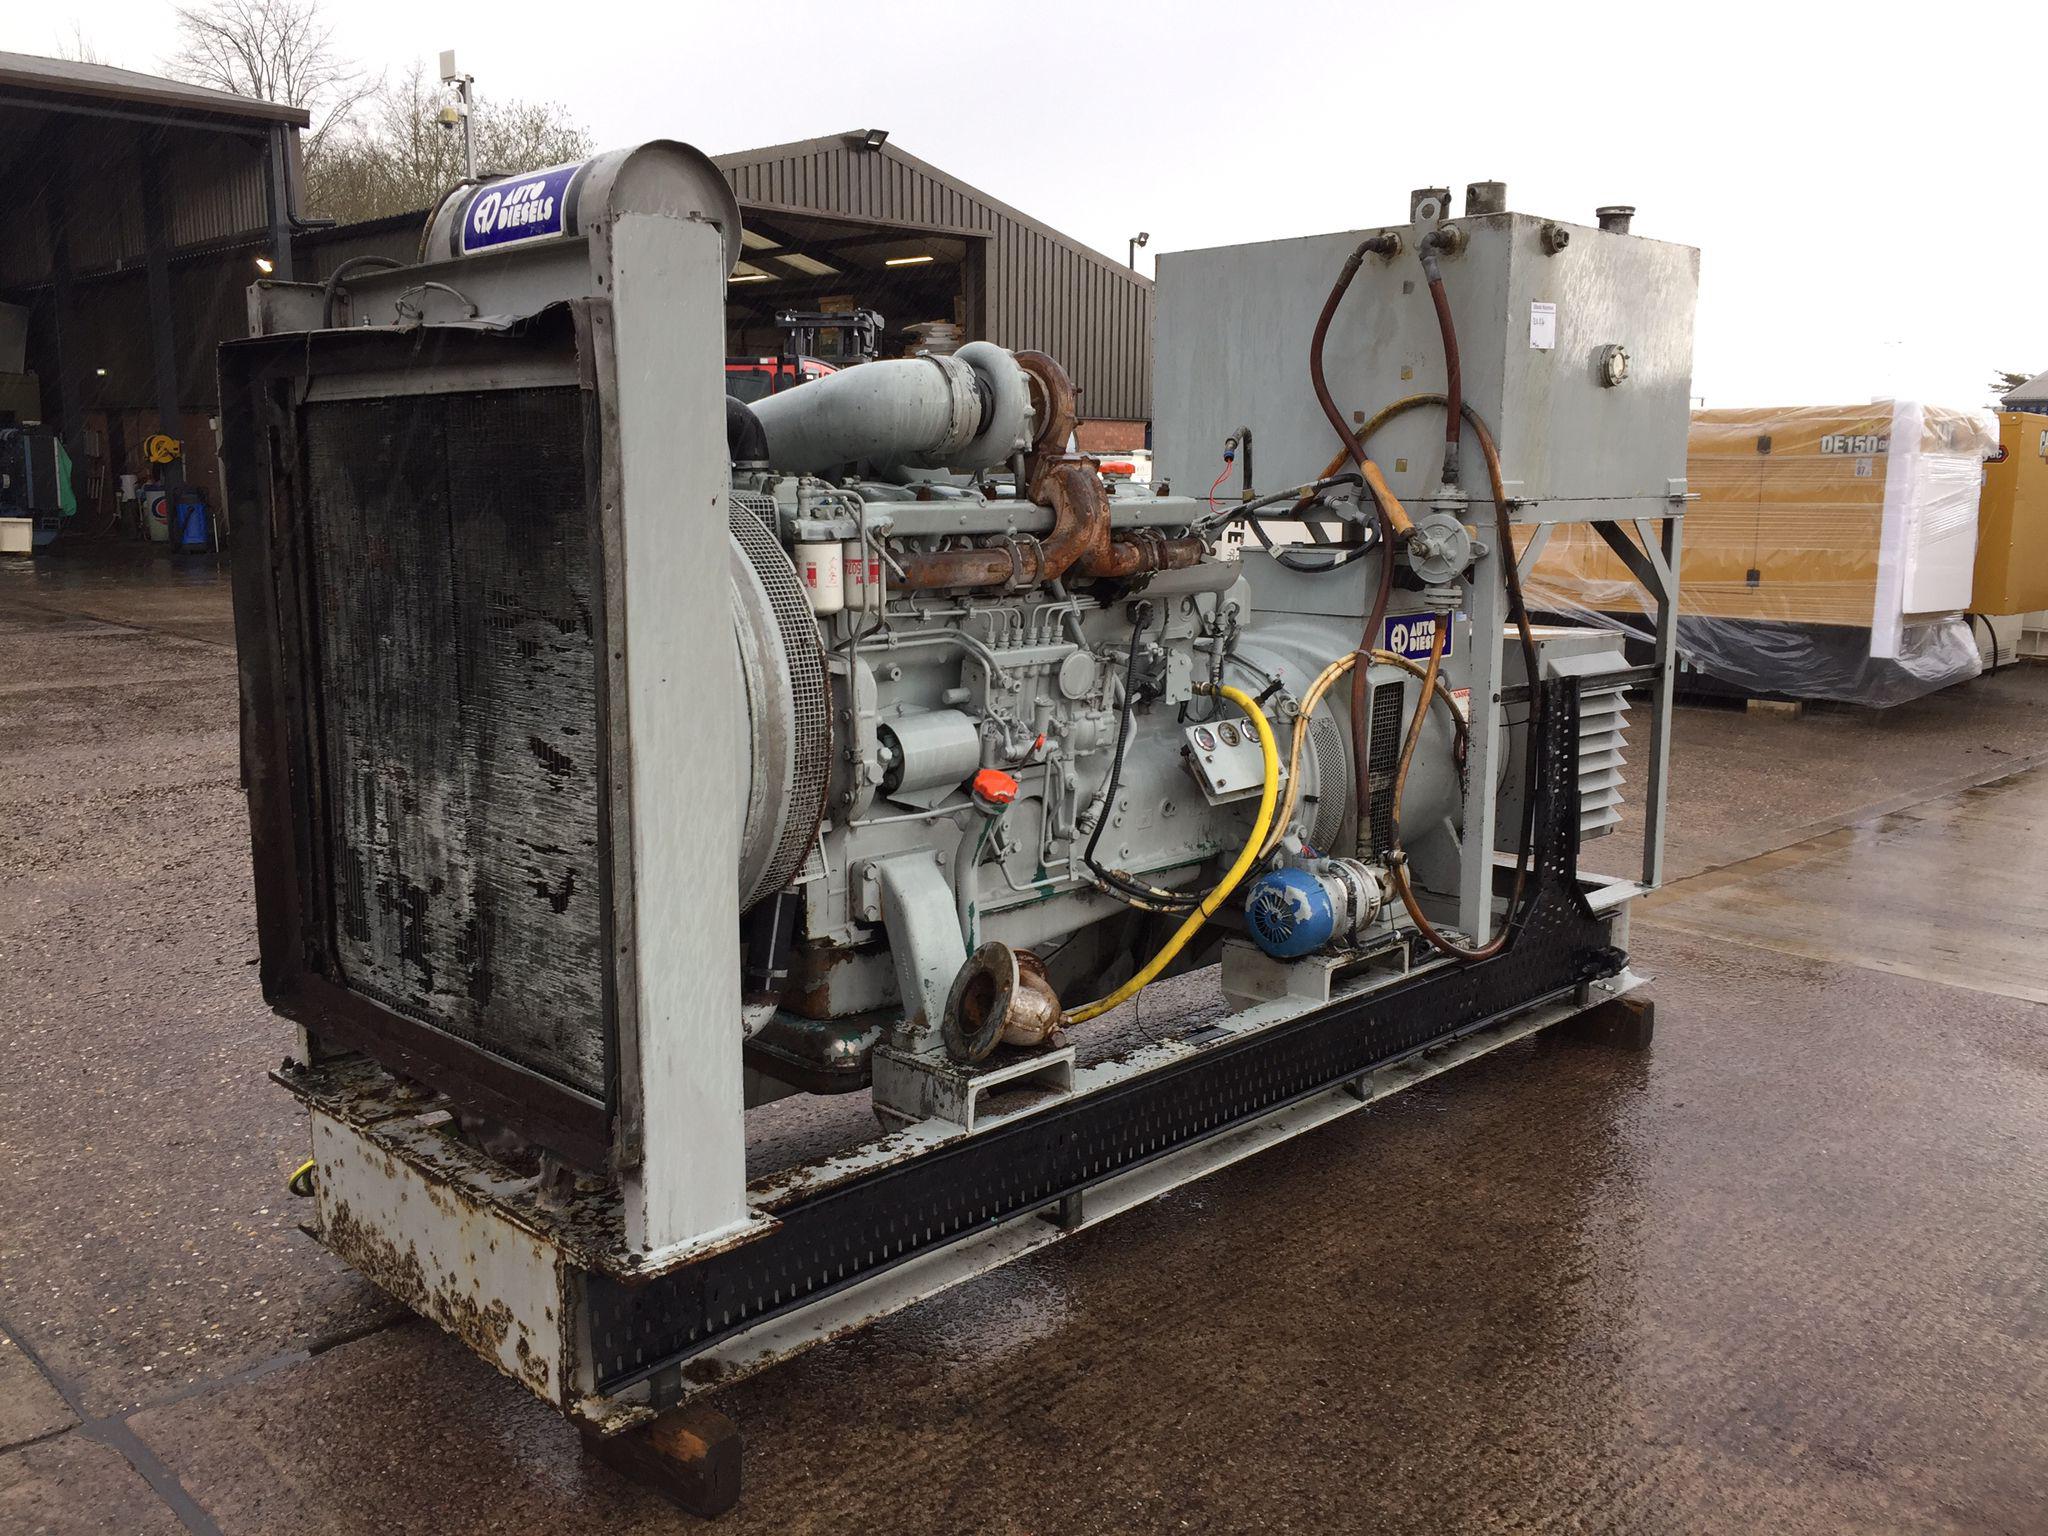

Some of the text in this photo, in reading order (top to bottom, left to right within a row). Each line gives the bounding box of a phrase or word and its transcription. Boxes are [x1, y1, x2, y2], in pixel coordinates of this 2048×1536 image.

[501, 180, 546, 207] AUTO
[497, 196, 554, 230] DIESELS
[1410, 620, 1436, 637] AUTO
